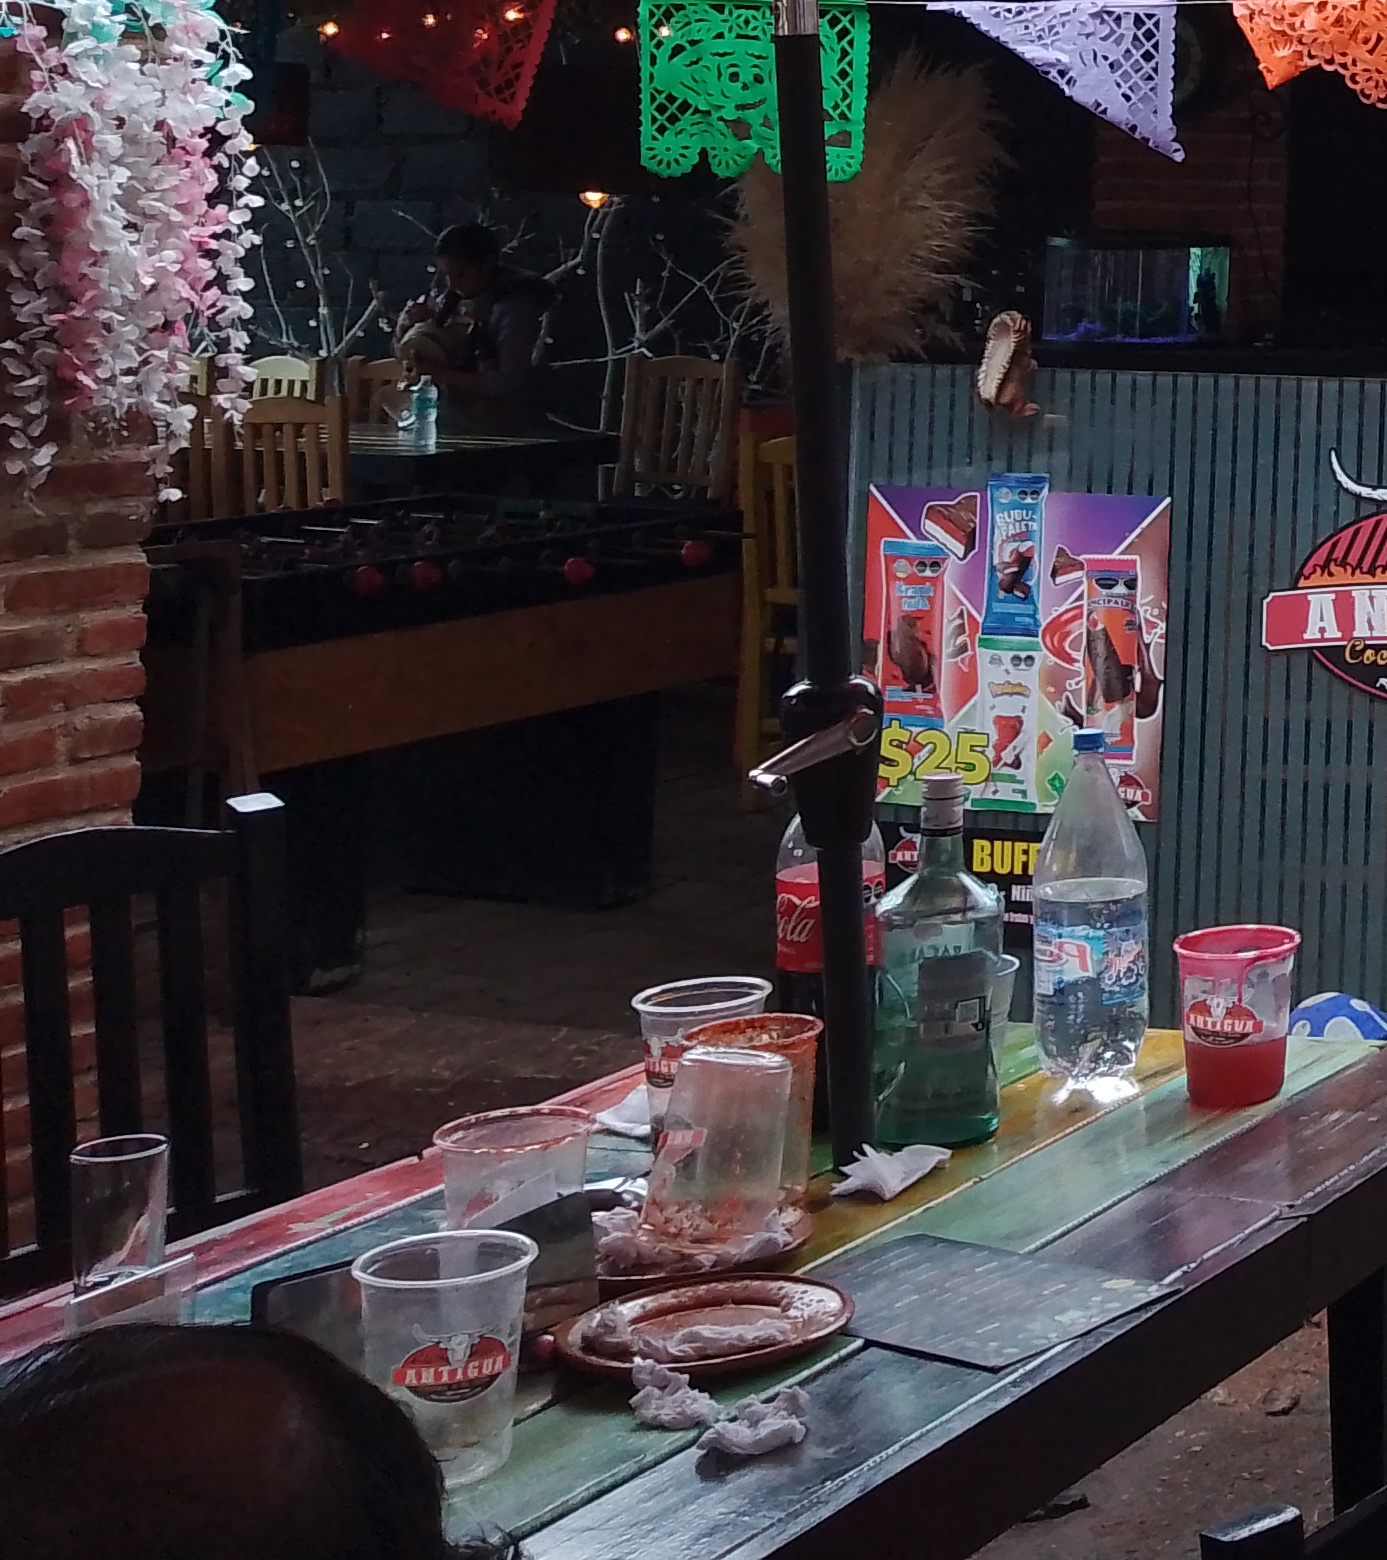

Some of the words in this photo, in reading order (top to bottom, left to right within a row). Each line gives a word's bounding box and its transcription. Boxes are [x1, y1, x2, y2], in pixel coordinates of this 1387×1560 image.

[878, 719, 991, 787] $25
[972, 838, 1041, 876] BUFF
[1189, 1013, 1254, 1033] ANTIGUA
[404, 1354, 505, 1387] ANTIGUA
